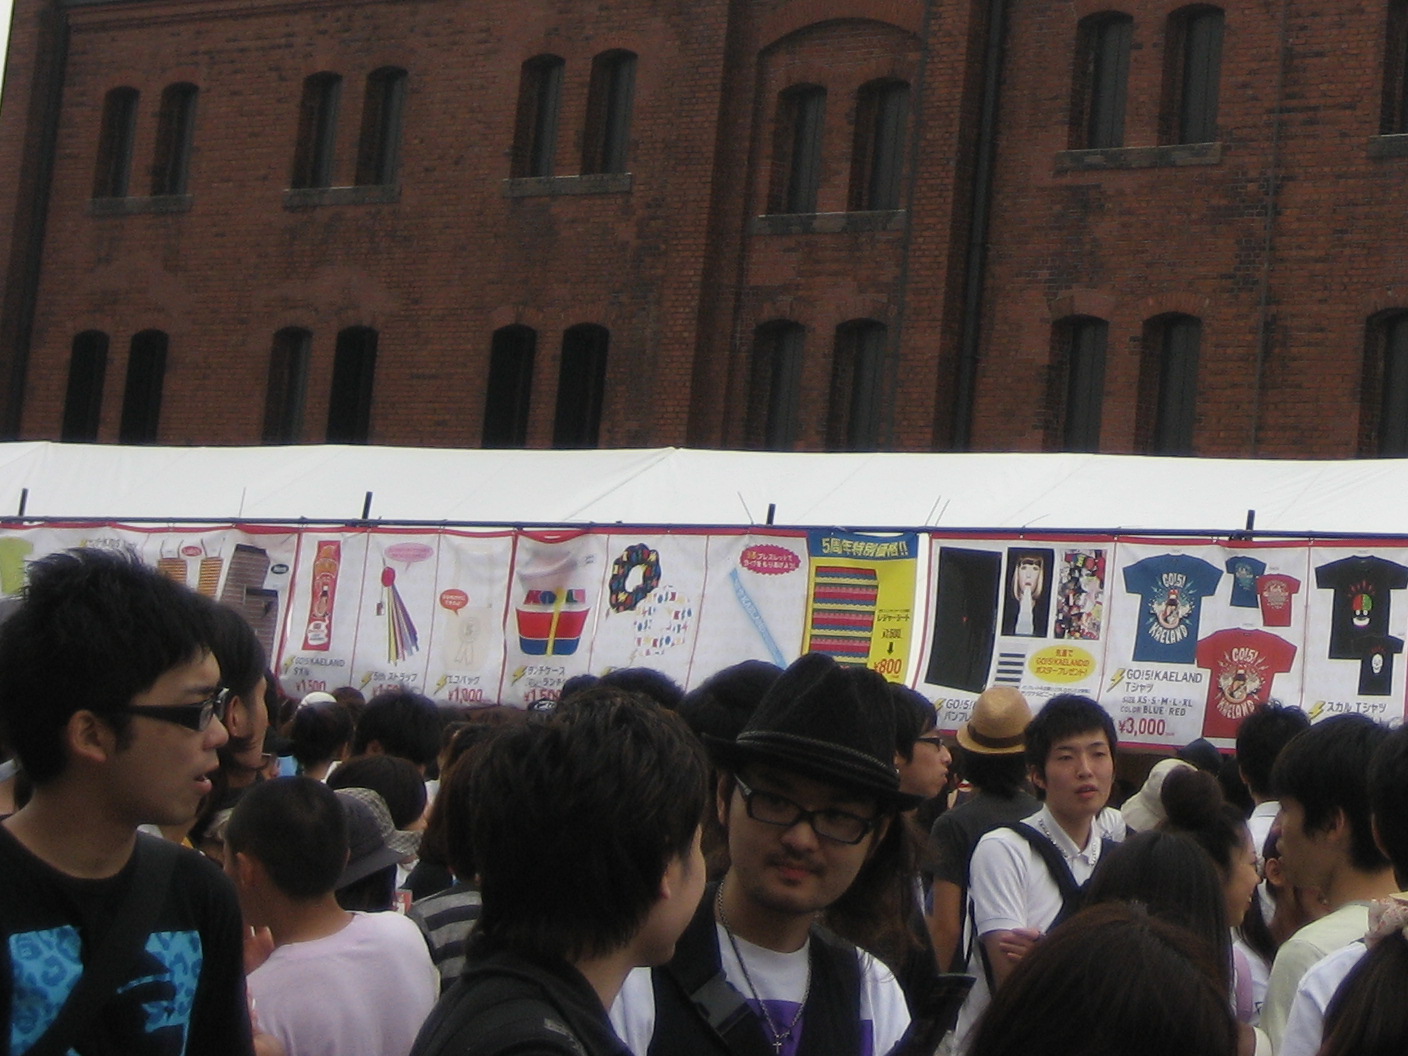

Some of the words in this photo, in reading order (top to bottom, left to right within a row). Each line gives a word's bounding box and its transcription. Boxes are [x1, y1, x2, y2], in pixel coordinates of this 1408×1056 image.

[1162, 572, 1187, 588] GO!5!
[1148, 623, 1190, 645] KAELAND
[1231, 647, 1258, 664] GO!5!
[873, 657, 903, 675] ¥800
[1126, 668, 1203, 684] GO!5!KAELAND
[1124, 681, 1154, 693] Tシャツ
[1215, 697, 1256, 719] KAELAND
[1326, 701, 1352, 714] スカル
[1355, 702, 1387, 714] Tシャツ
[1117, 716, 1167, 737] ¥3,000
